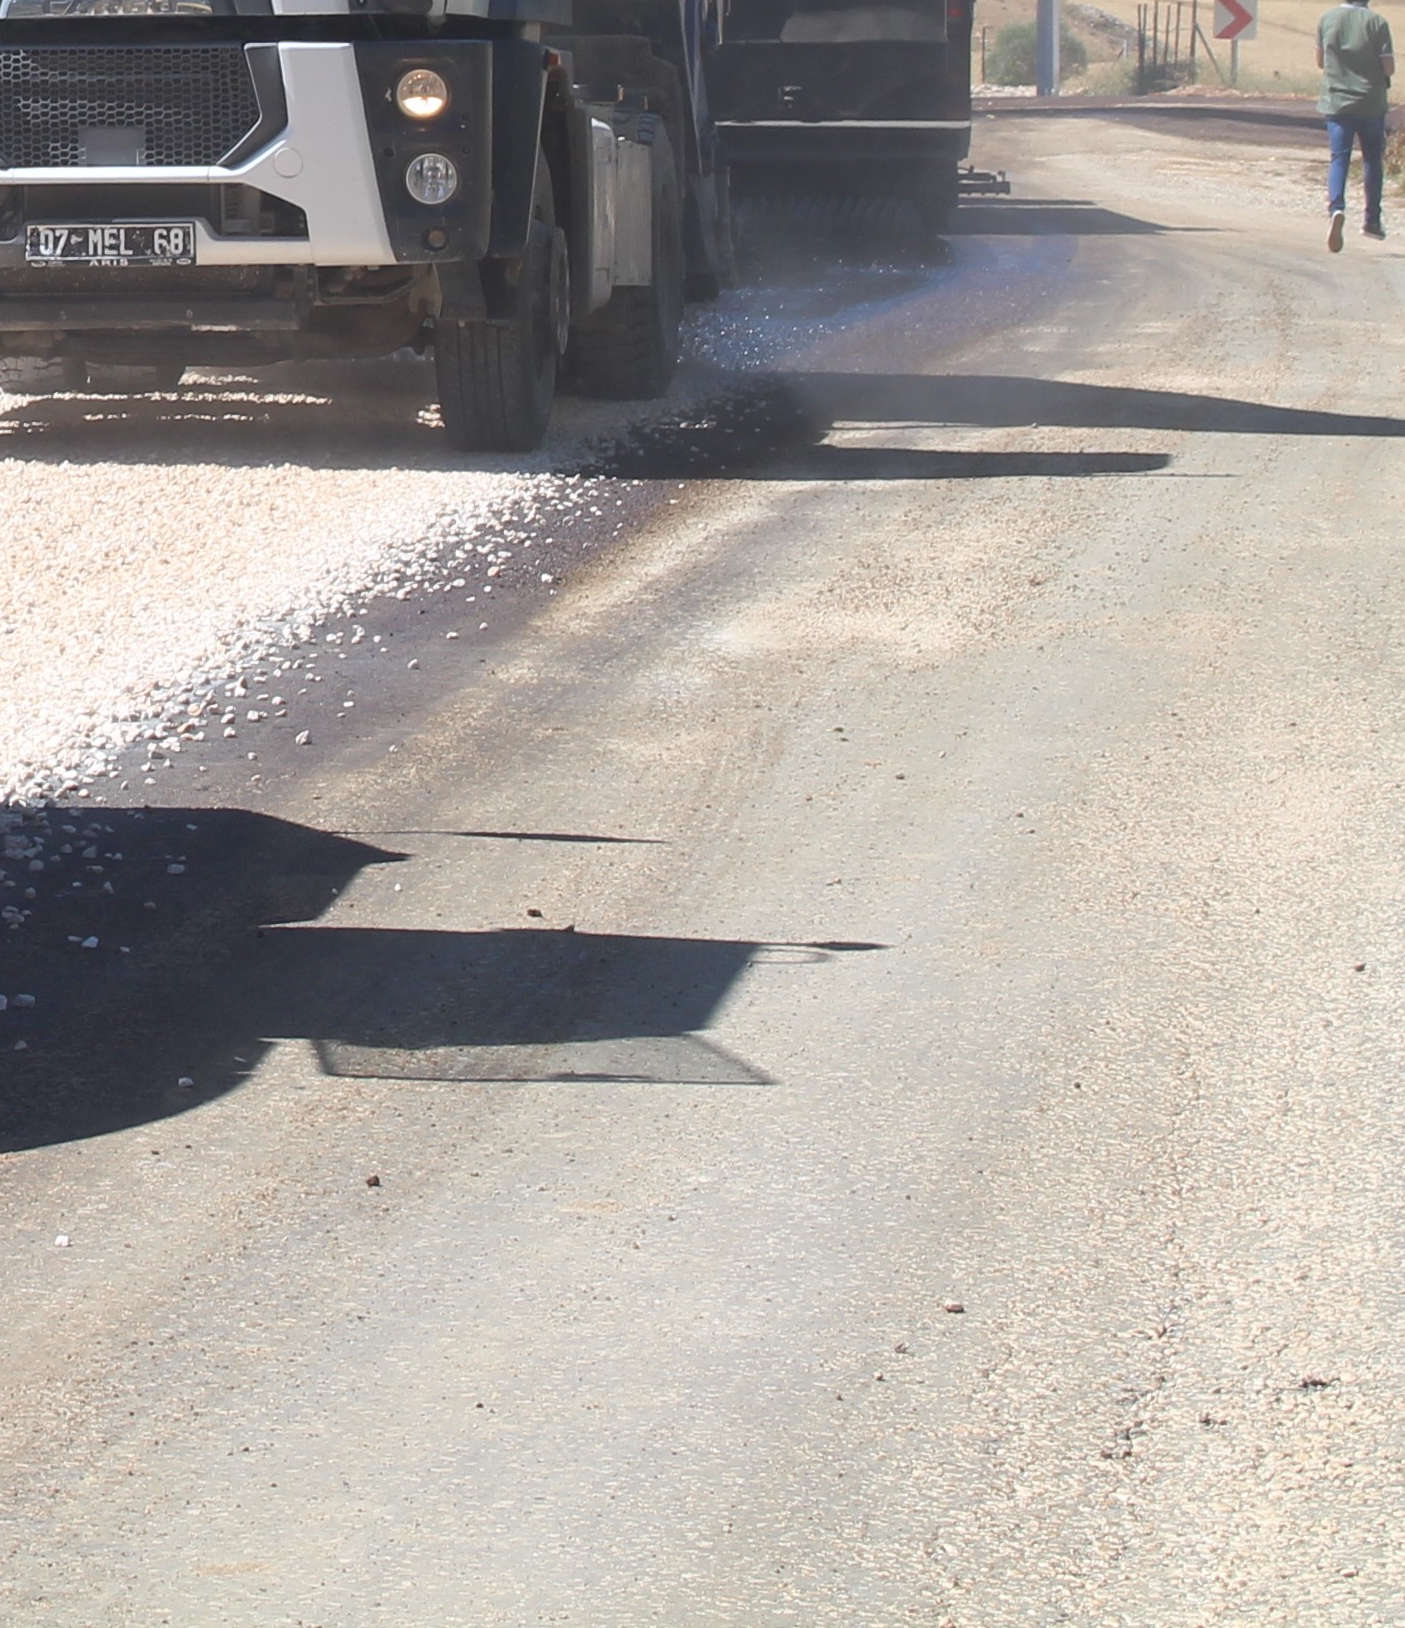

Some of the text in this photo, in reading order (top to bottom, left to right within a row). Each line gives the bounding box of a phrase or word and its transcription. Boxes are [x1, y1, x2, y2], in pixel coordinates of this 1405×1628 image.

[40, 227, 184, 256] 07 MEL 68
